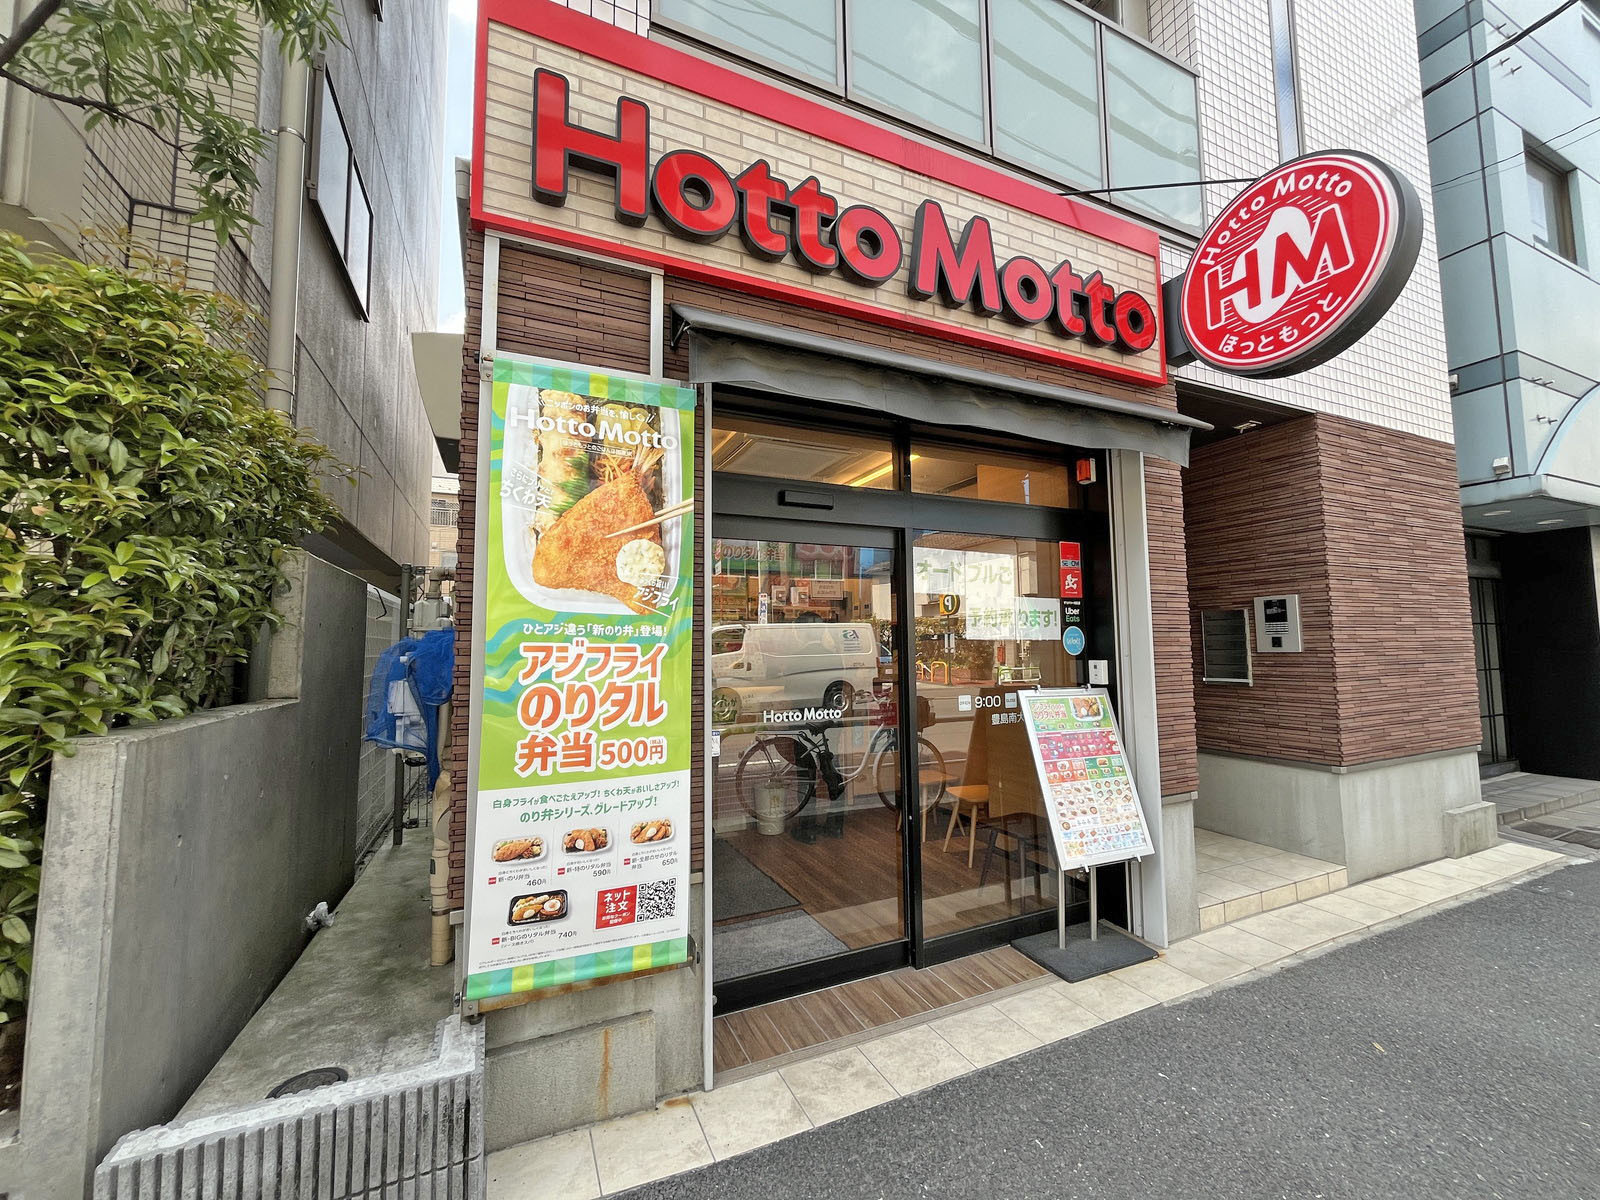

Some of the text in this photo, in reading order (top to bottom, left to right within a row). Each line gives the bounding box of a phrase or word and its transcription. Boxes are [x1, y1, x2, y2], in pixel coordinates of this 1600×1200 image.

[532, 67, 1158, 355] Hotto Motto
[1200, 173, 1353, 266] Hotto Motto
[1218, 292, 1343, 355] ほっともっと
[511, 406, 678, 450] Hotto Motto
[500, 479, 553, 509] ちくわ天
[633, 586, 679, 612] アジフライ
[1065, 607, 1080, 615] Uber
[521, 639, 666, 682] アジフライ
[520, 681, 665, 729] のりタル
[763, 707, 842, 724] Hotto Motto
[974, 695, 1002, 709] 9:00
[517, 731, 664, 773] 弁当 500円
[492, 780, 680, 809] 白身フライが食べごたえアップ! ちくわ天がおいしさアップ!
[604, 889, 631, 902] ネット
[605, 901, 629, 914] 注文
